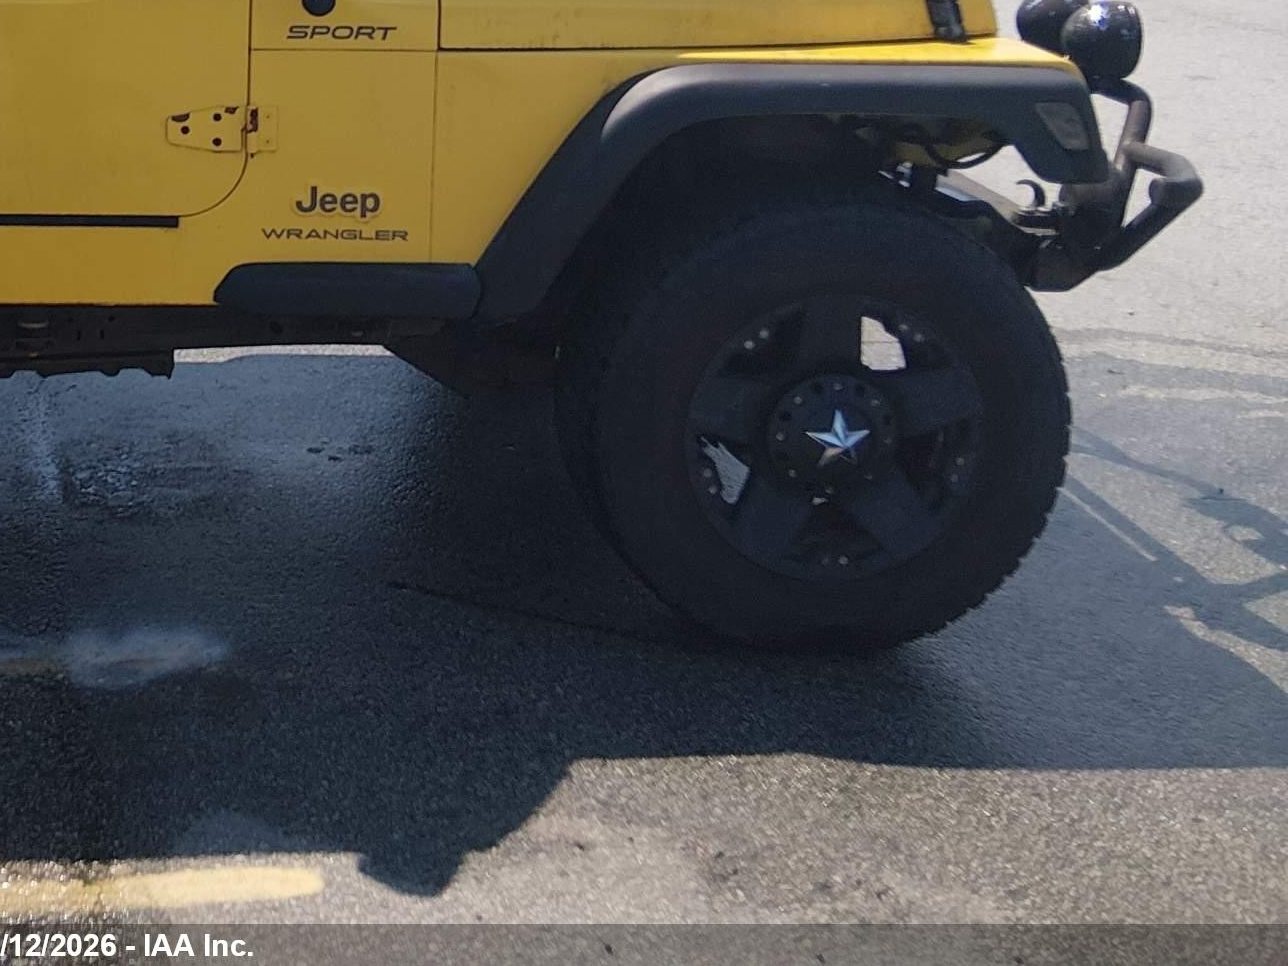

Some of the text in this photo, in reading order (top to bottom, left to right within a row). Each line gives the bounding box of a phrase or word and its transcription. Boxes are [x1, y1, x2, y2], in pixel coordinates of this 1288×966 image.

[286, 25, 397, 40] SPORT
[295, 185, 381, 218] Jeep
[261, 228, 409, 241] WRANGLER
